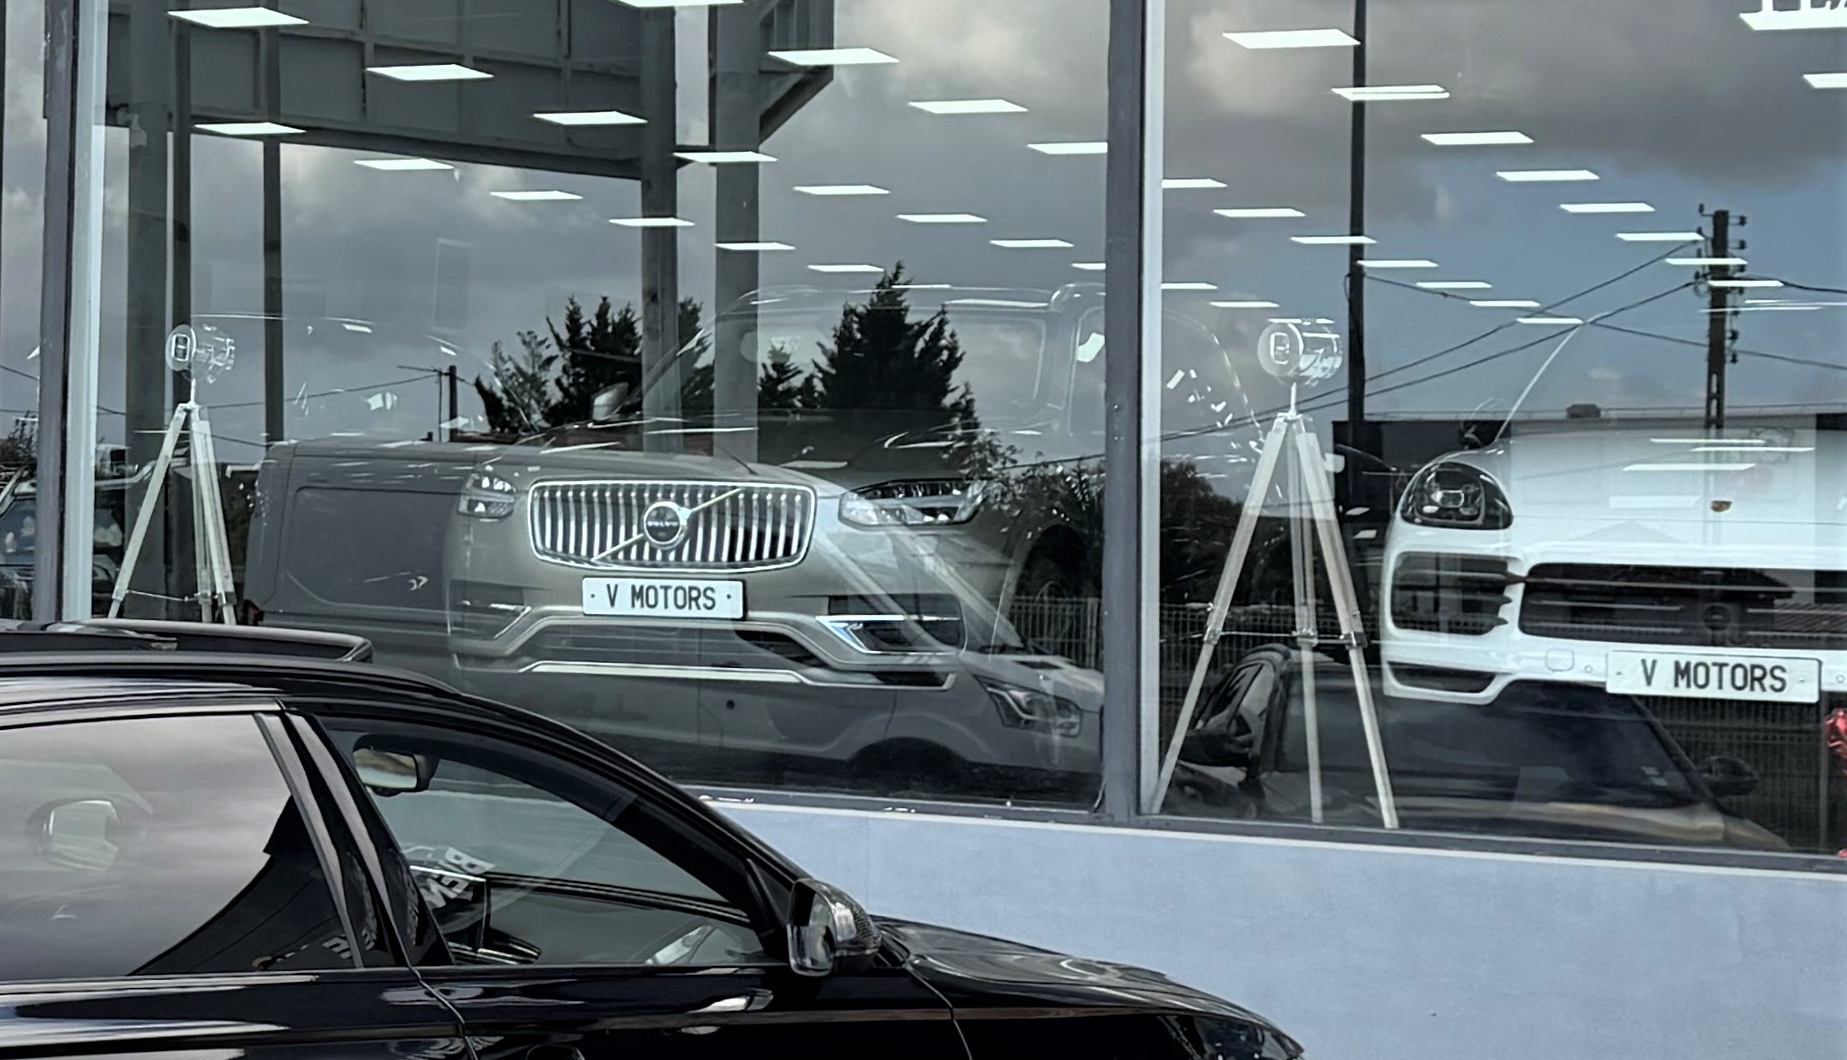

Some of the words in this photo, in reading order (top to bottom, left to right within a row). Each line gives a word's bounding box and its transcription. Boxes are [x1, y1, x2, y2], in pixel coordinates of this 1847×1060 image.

[606, 583, 618, 608] V
[630, 584, 716, 611] MOTORS
[1641, 658, 1657, 687] V
[1673, 660, 1787, 693] MOTORS
